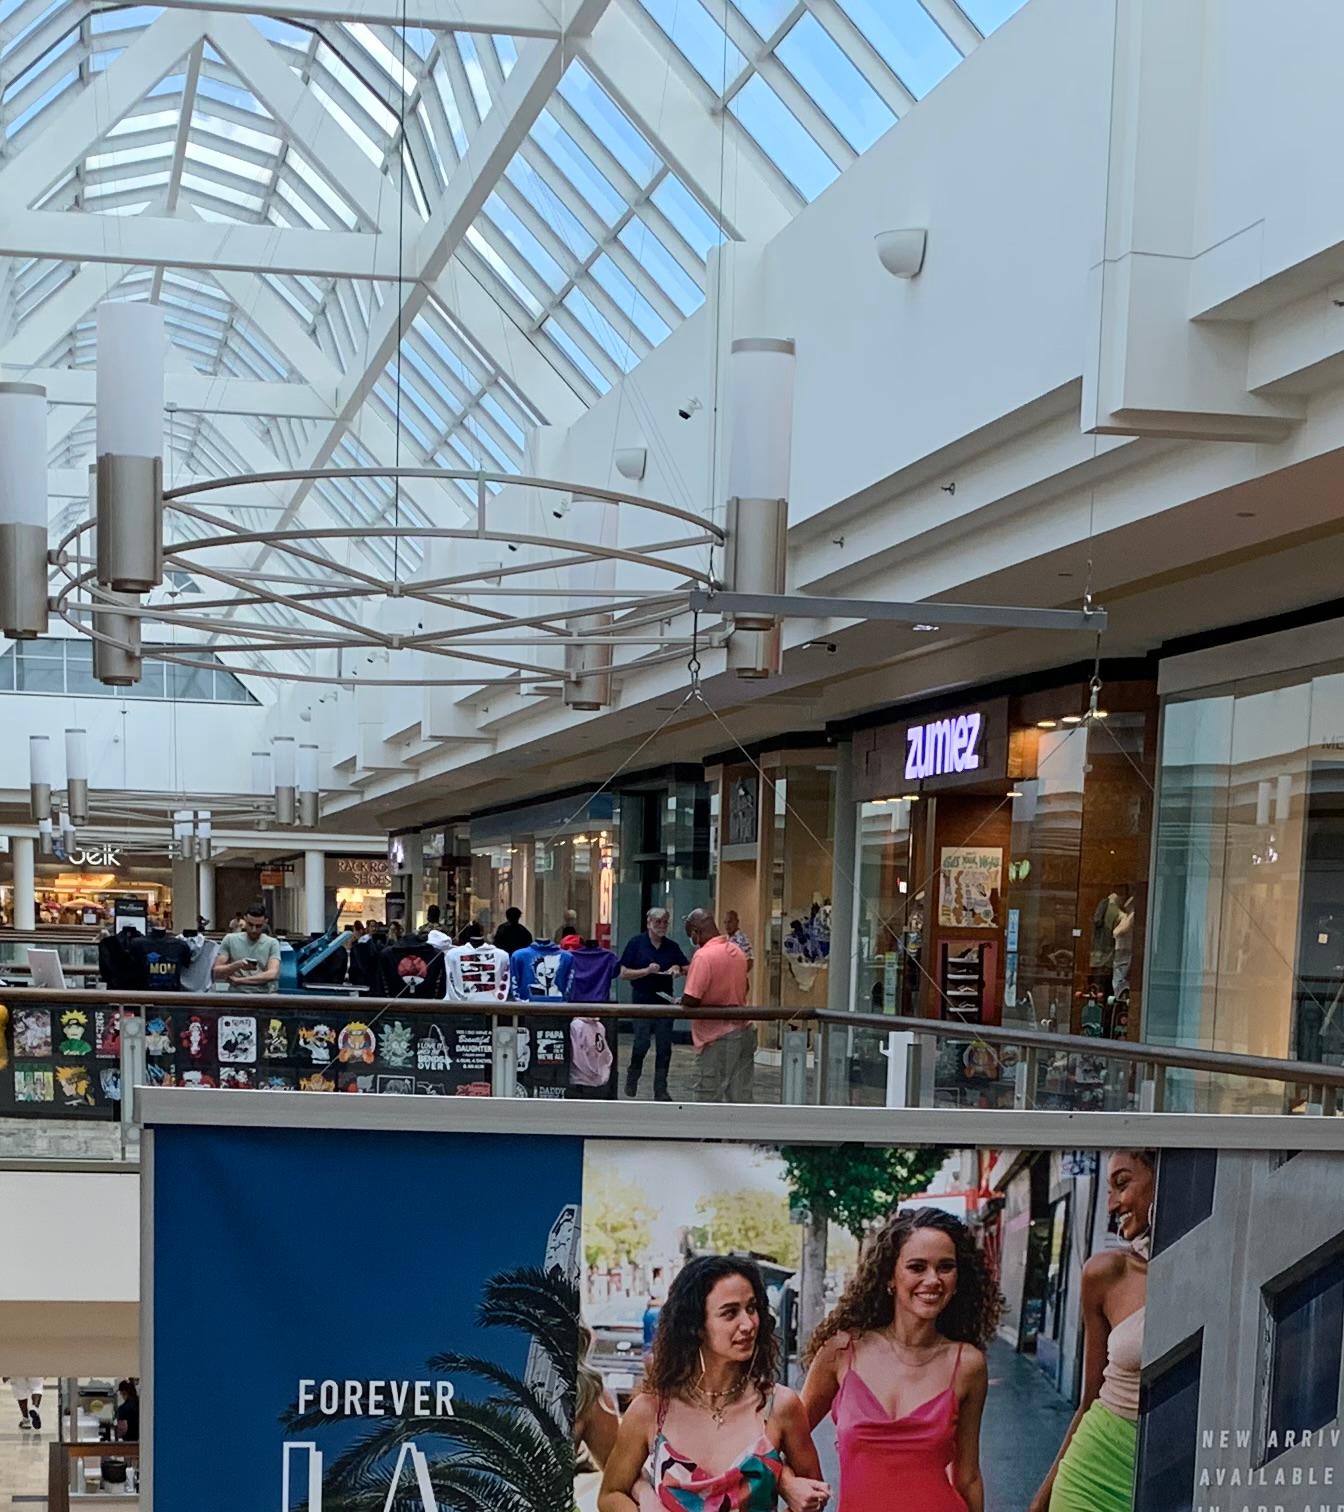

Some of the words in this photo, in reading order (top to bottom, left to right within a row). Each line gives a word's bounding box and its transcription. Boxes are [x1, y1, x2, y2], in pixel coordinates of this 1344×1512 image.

[905, 712, 980, 779] zumiez
[370, 859, 388, 873] RO
[149, 963, 176, 974] MOM
[298, 1379, 457, 1417] FOREVER
[1201, 1430, 1251, 1449] NEW
[1199, 1467, 1335, 1487] AVAILABLE
